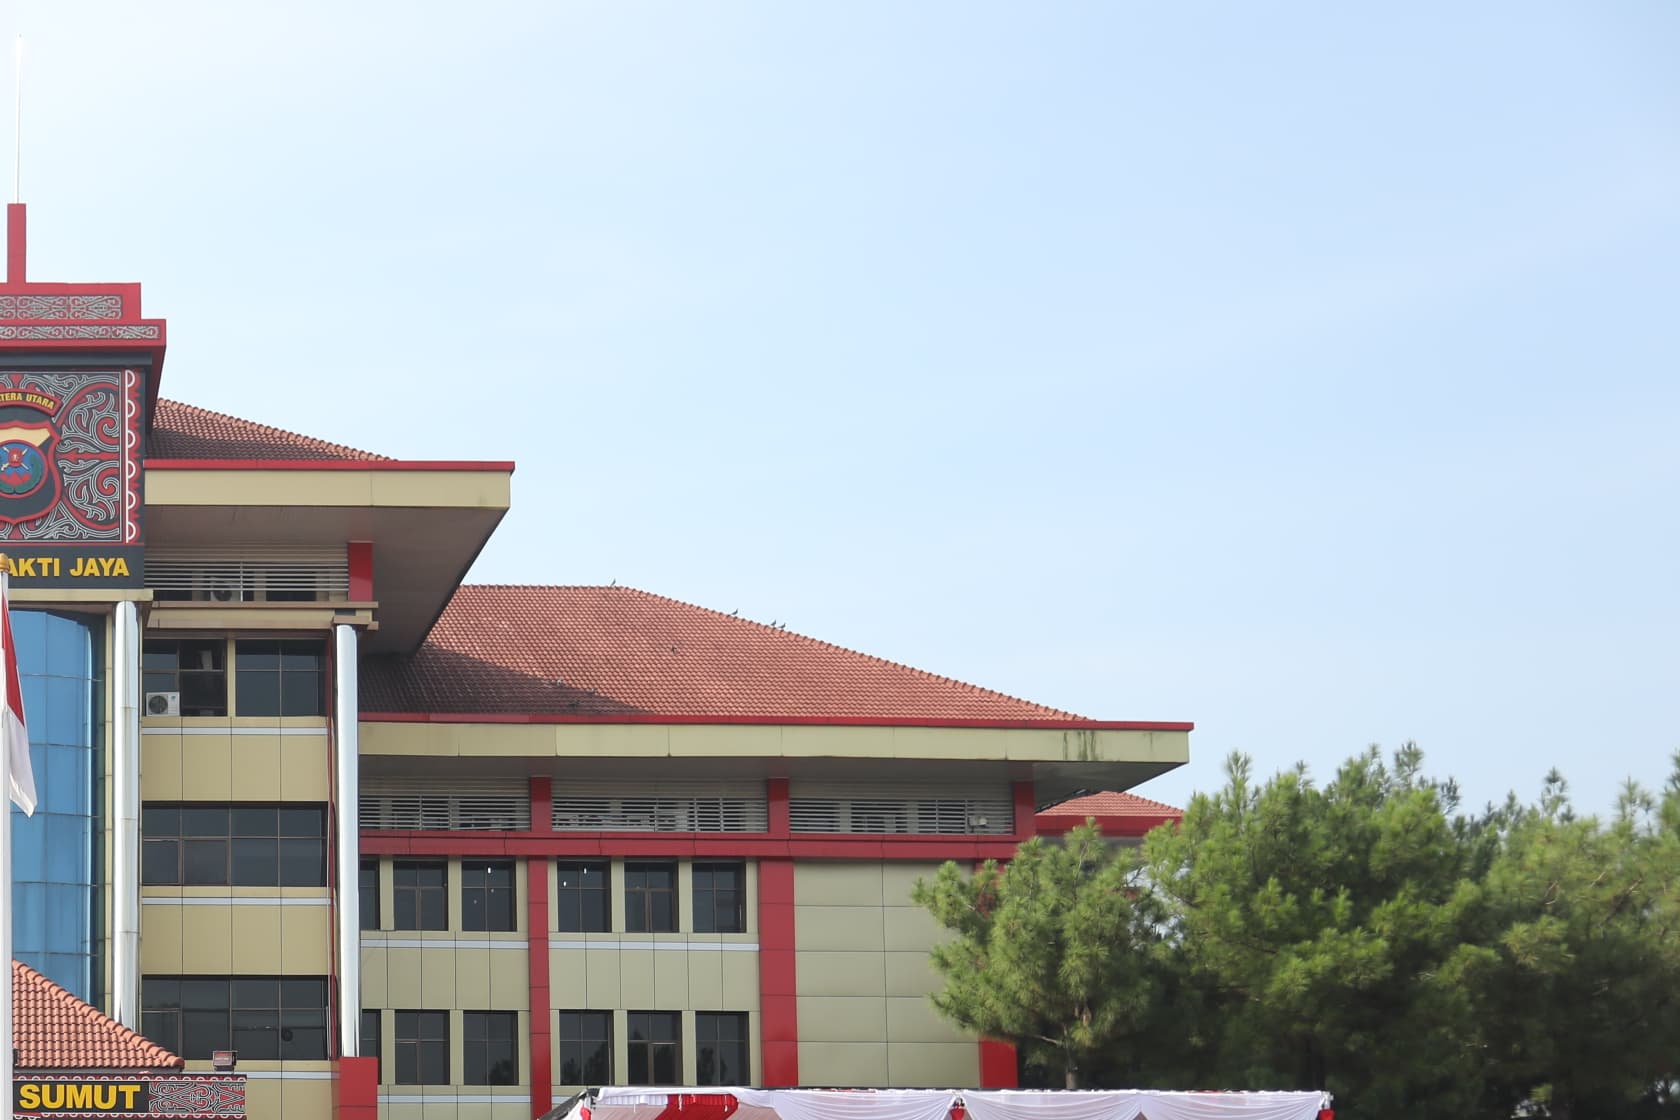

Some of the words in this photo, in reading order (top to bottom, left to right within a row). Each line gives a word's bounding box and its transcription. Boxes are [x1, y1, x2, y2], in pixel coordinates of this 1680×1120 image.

[26, 393, 55, 409] UTARA
[69, 558, 130, 577] JAYA
[20, 1084, 141, 1109] SUMUT
